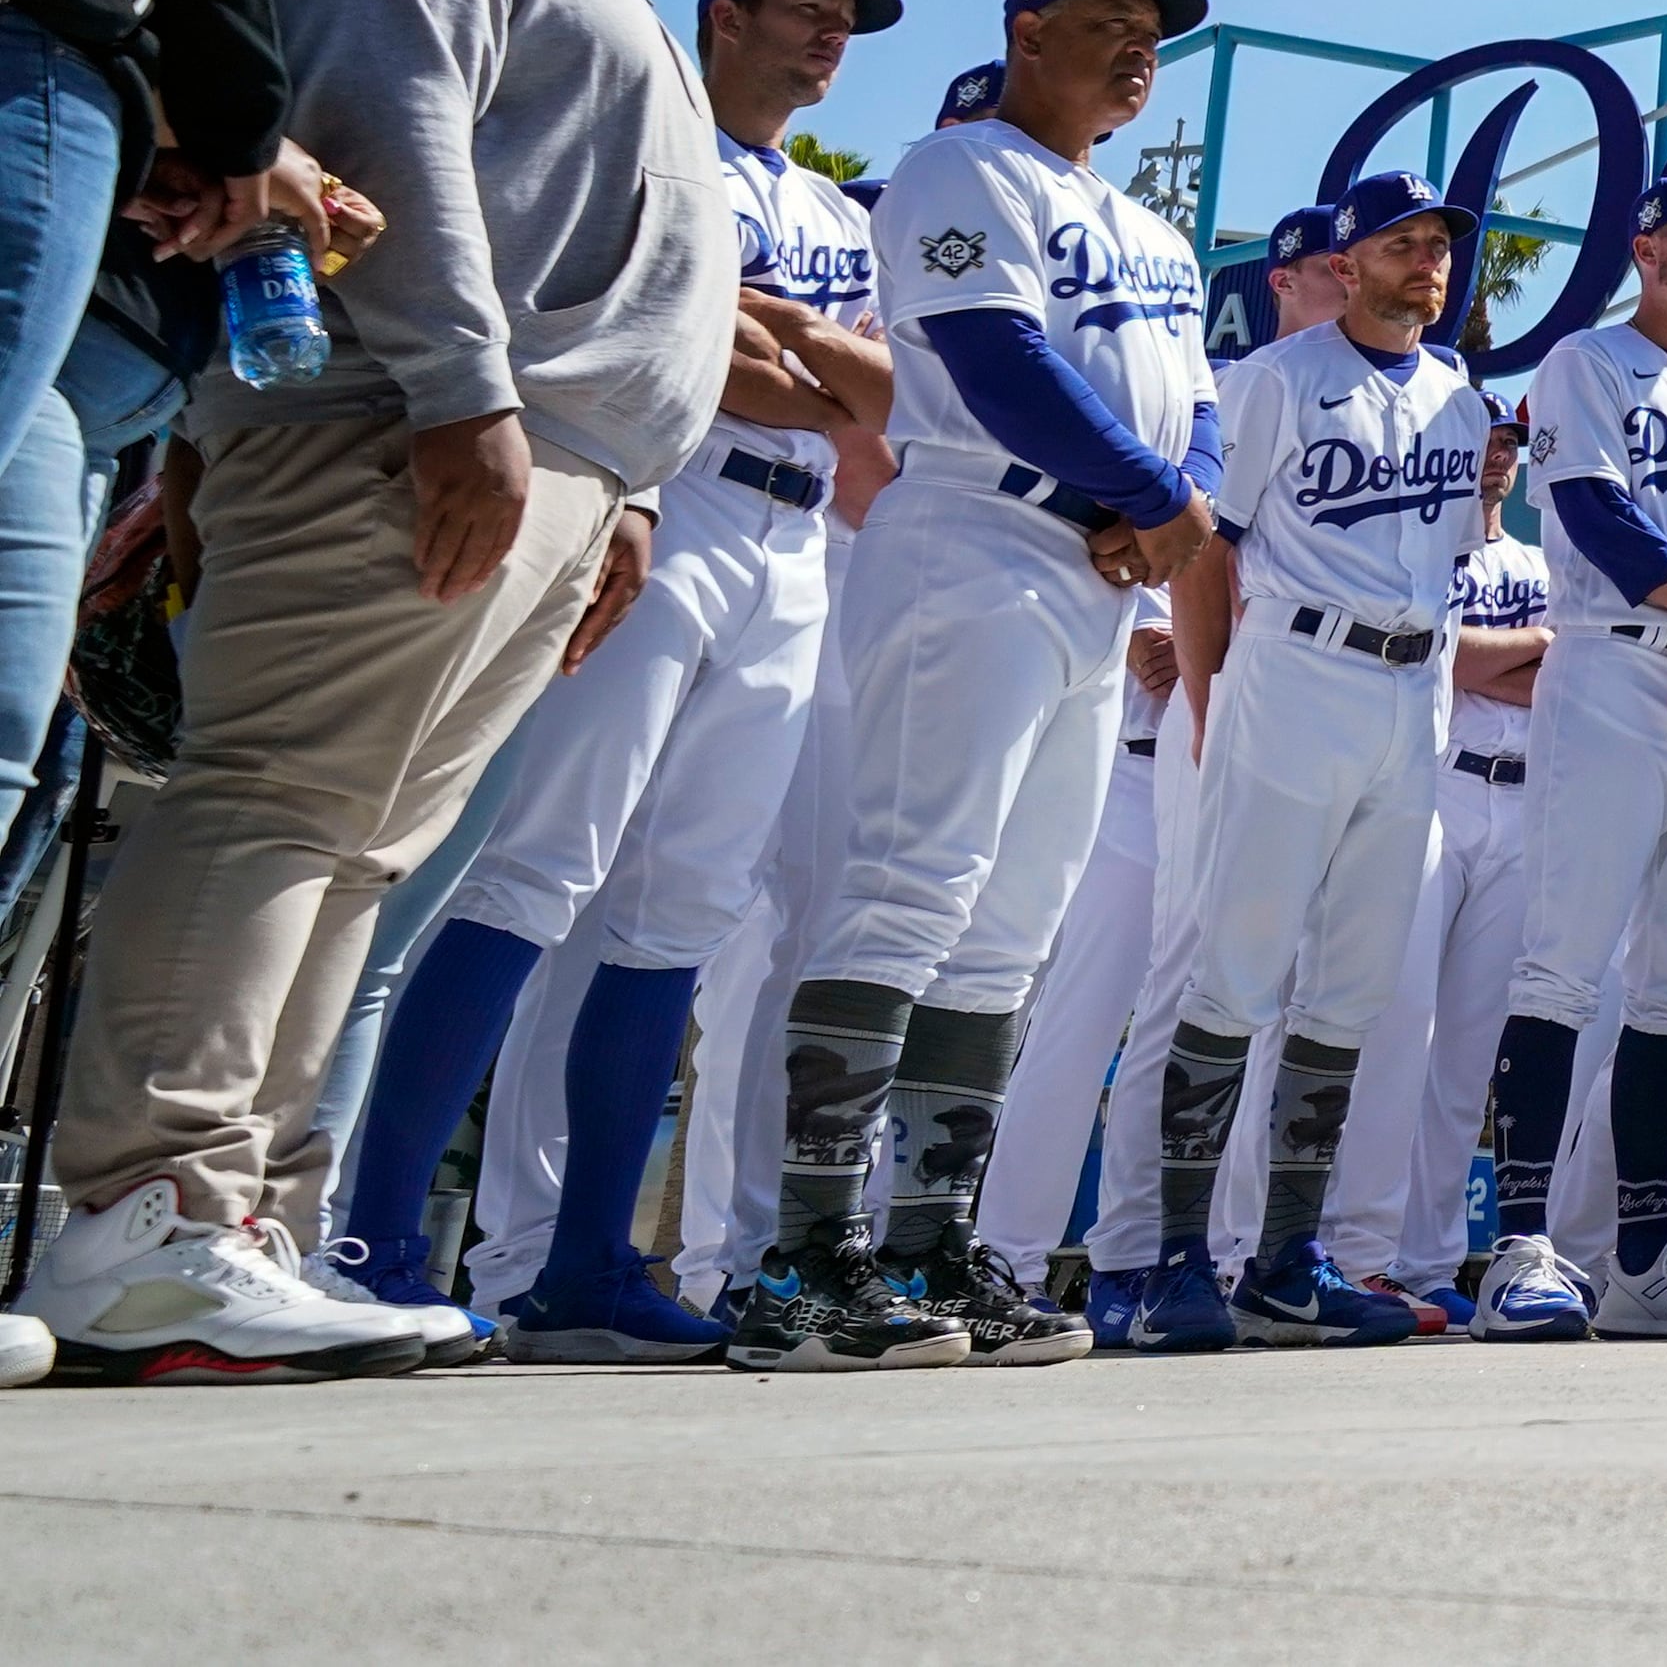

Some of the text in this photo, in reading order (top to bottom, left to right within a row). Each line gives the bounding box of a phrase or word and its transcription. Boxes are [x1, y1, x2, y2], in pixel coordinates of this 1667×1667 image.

[1400, 173, 1433, 201] LA
[940, 244, 966, 262] 42
[1048, 222, 1202, 338] Dodger
[1297, 433, 1479, 531] Dodger
[1466, 1176, 1488, 1222] 2
